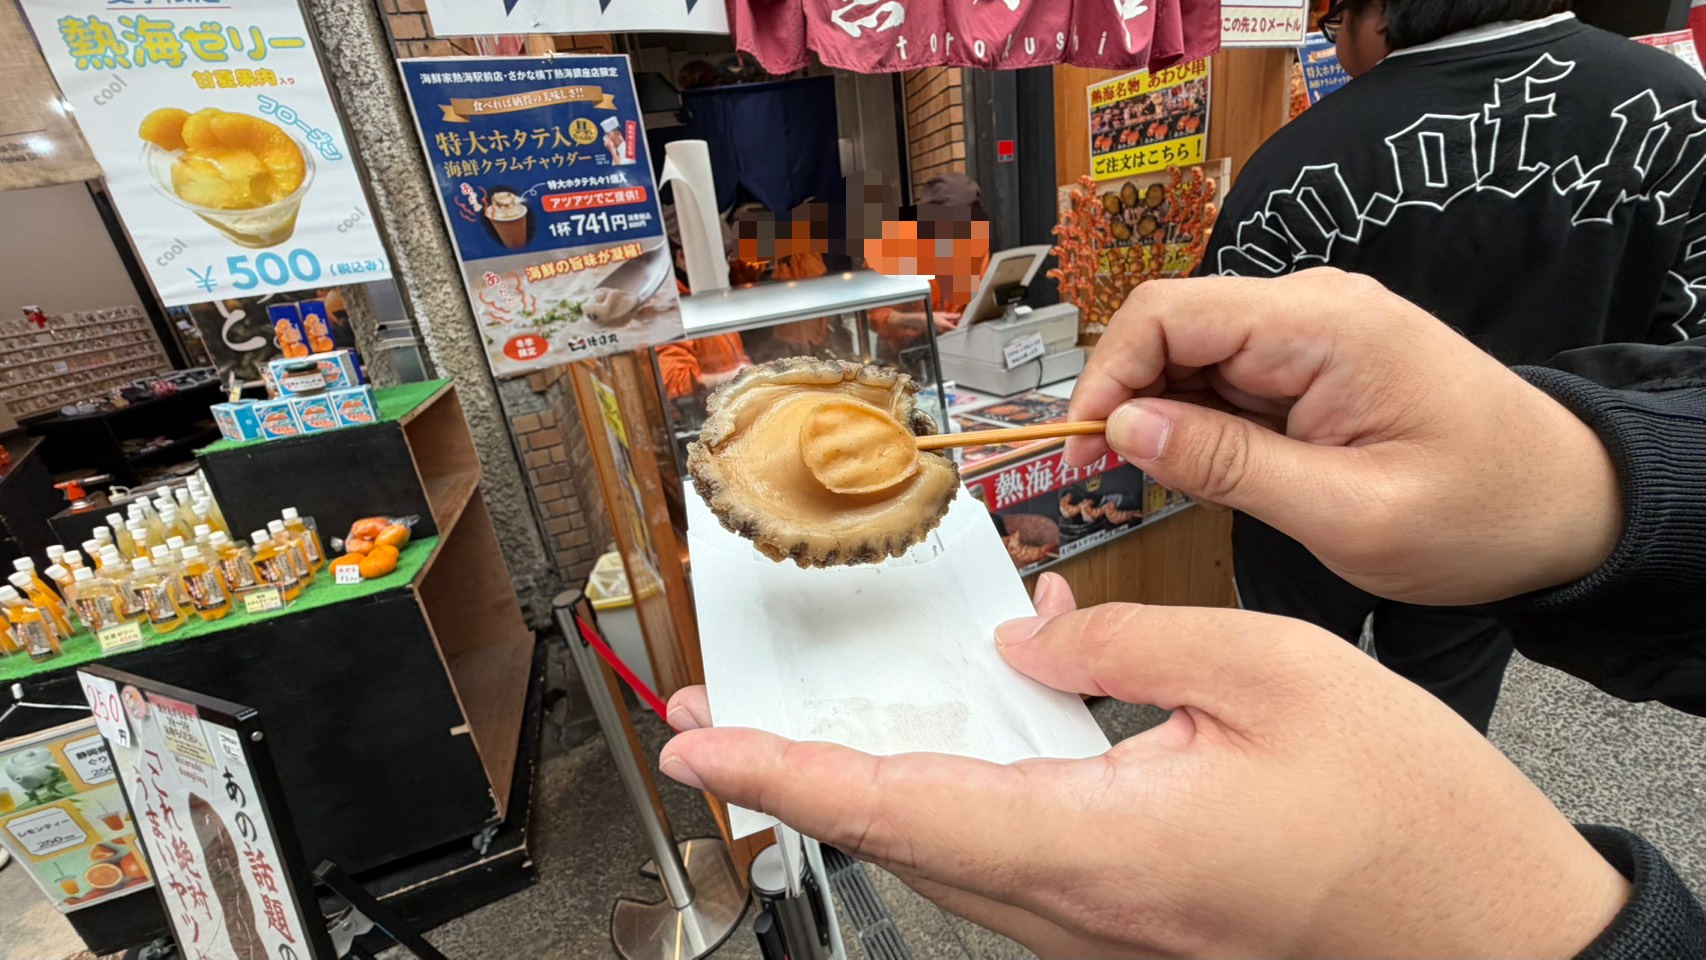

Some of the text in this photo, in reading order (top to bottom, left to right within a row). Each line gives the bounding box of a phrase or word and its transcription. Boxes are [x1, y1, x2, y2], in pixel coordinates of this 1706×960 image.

[58, 15, 304, 70] 熱海ゼリー
[93, 75, 127, 106] cool
[191, 68, 278, 89] 甘夏果肉
[435, 126, 572, 157] 特大ホタテ入
[1095, 139, 1202, 174] ご注文はこちら！
[444, 151, 592, 178] 海鮮クラムチャウダー
[337, 206, 365, 233] cool
[156, 238, 188, 267] cool
[524, 242, 643, 283] 海鮮の旨味が凝縮!
[86, 685, 119, 722] 250
[17, 819, 70, 838] レモンティー
